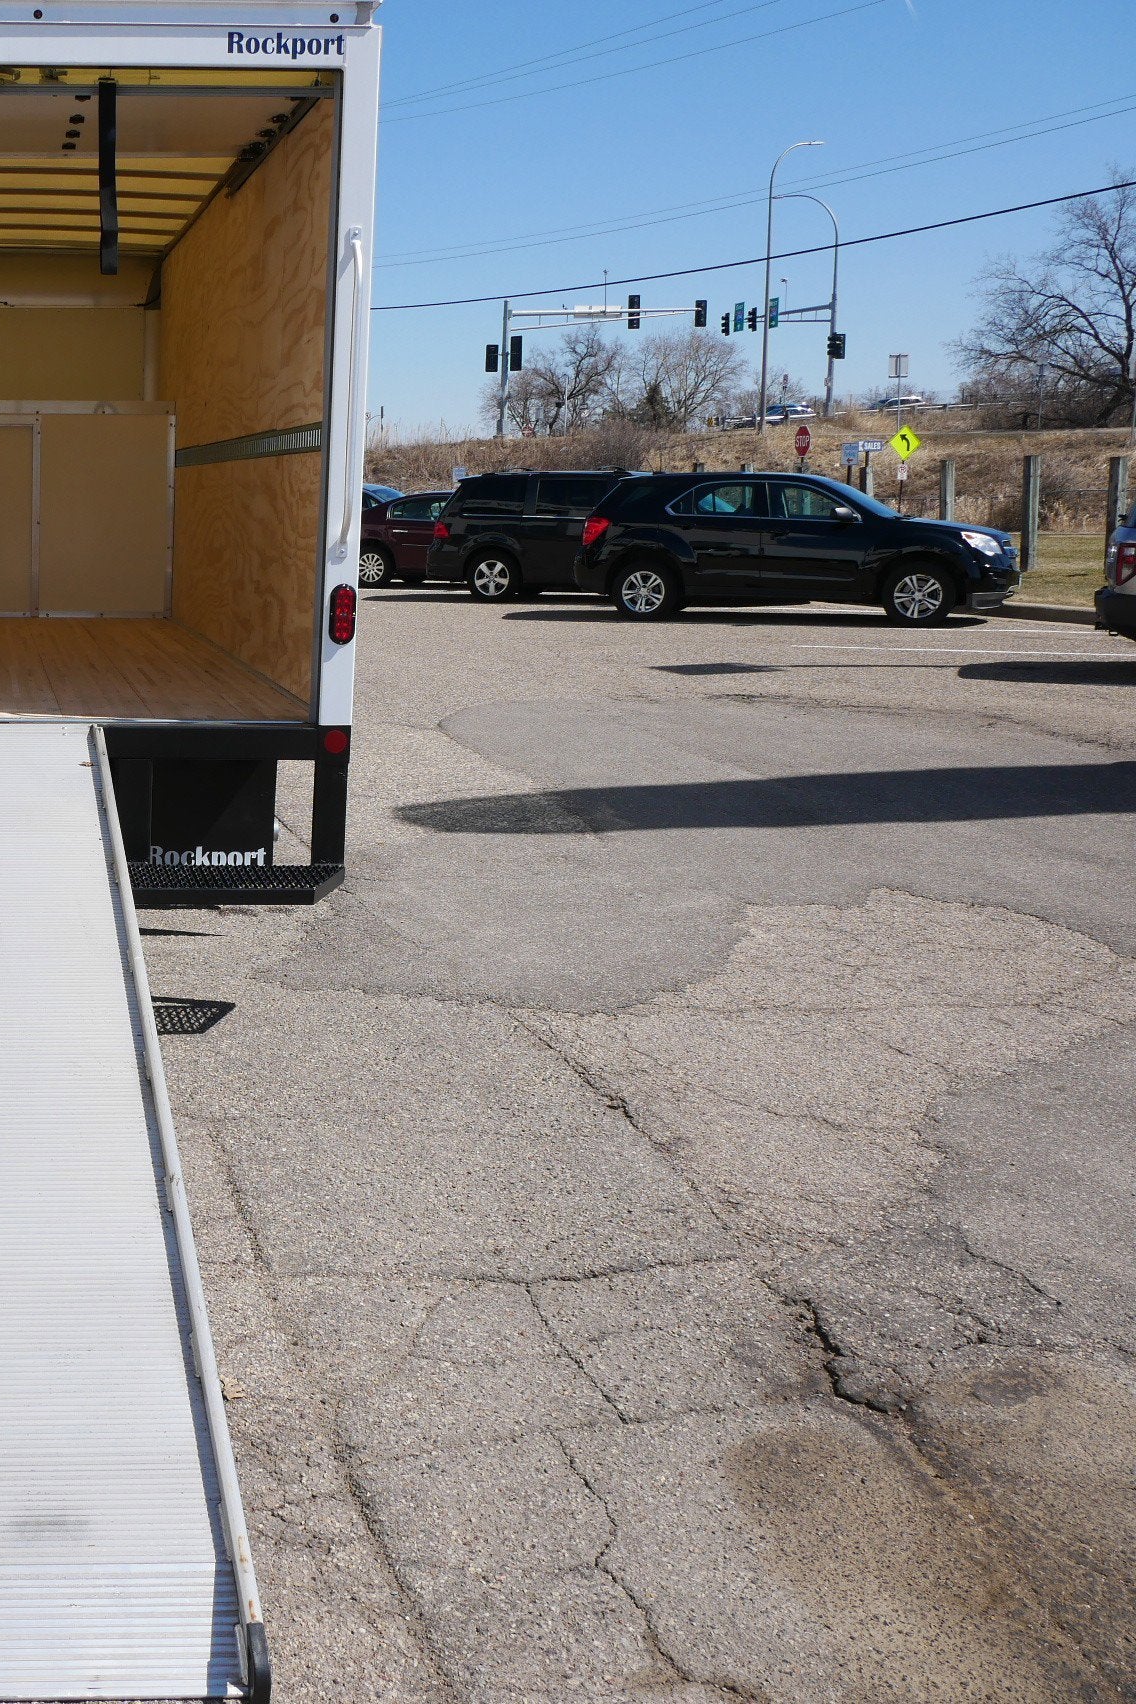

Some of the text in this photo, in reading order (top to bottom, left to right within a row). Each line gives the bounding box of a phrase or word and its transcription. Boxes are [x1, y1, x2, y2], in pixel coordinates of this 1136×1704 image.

[227, 31, 345, 60] Rockport
[795, 435, 811, 448] STOP
[864, 442, 882, 451] SALES
